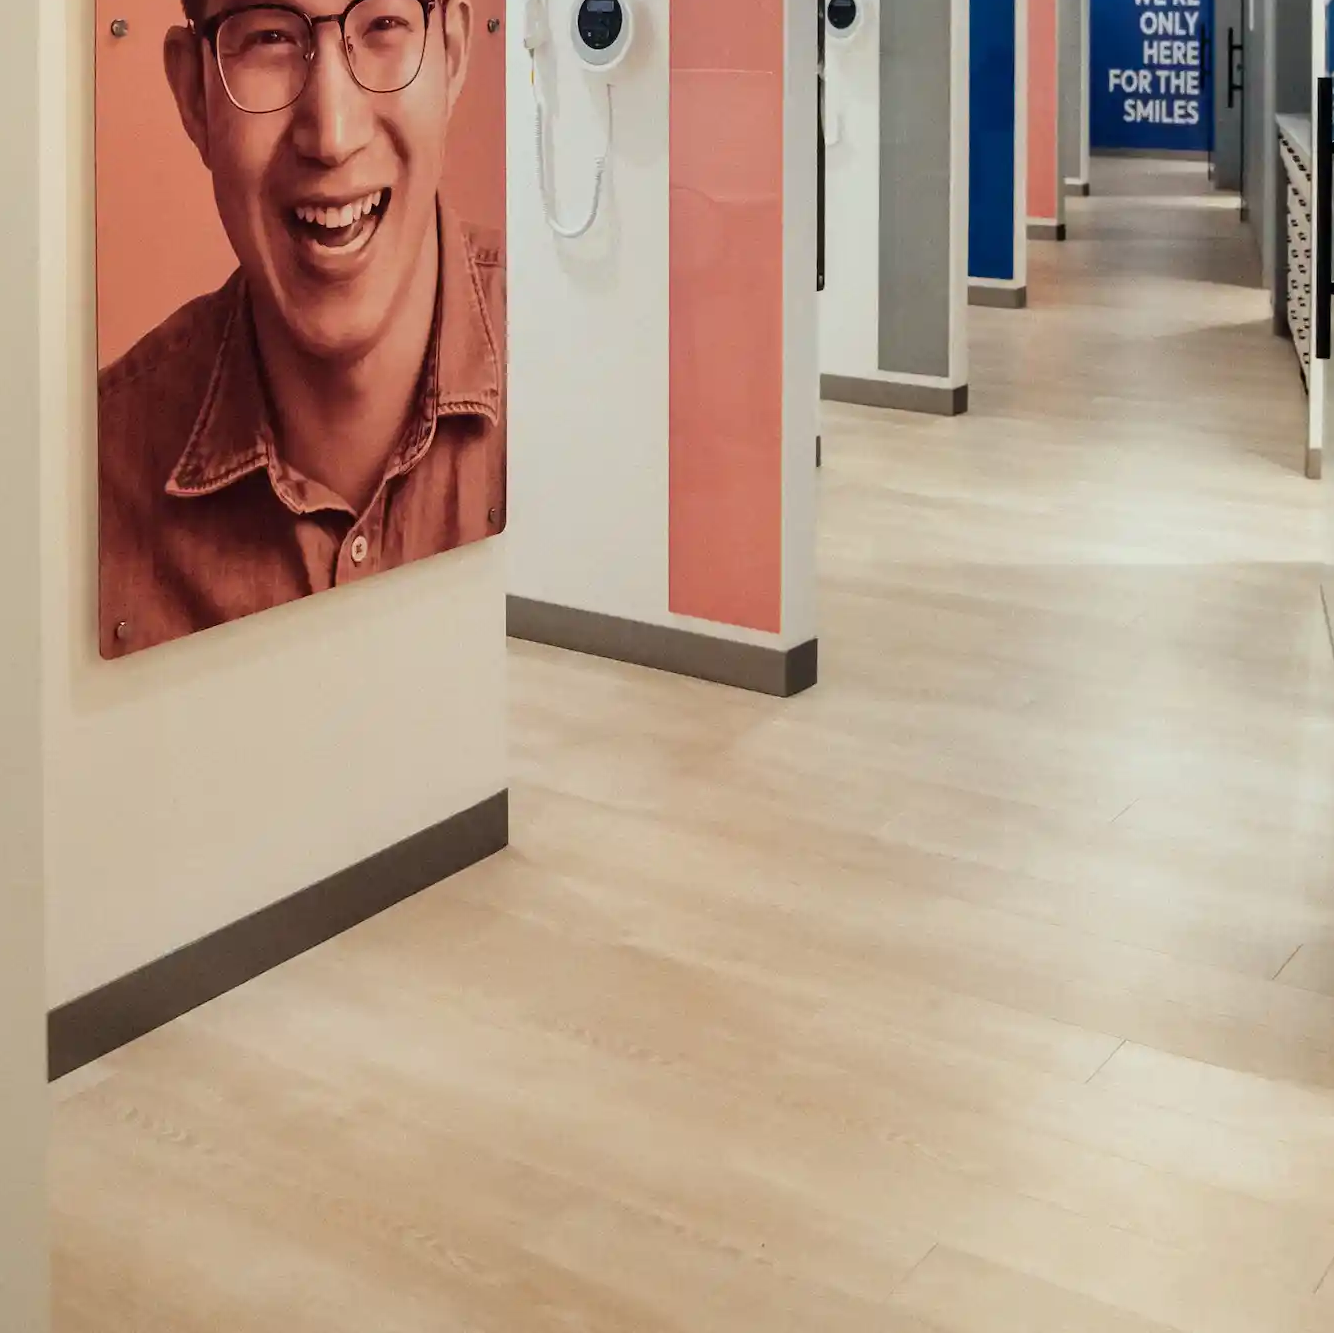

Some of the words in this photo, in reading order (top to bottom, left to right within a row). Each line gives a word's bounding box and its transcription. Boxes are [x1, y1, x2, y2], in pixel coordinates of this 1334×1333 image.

[1140, 11, 1199, 36] ONLY
[1143, 41, 1199, 65] HERE
[1108, 70, 1152, 94] FOR
[1156, 70, 1200, 96] THE
[1123, 100, 1200, 125] SMILES
